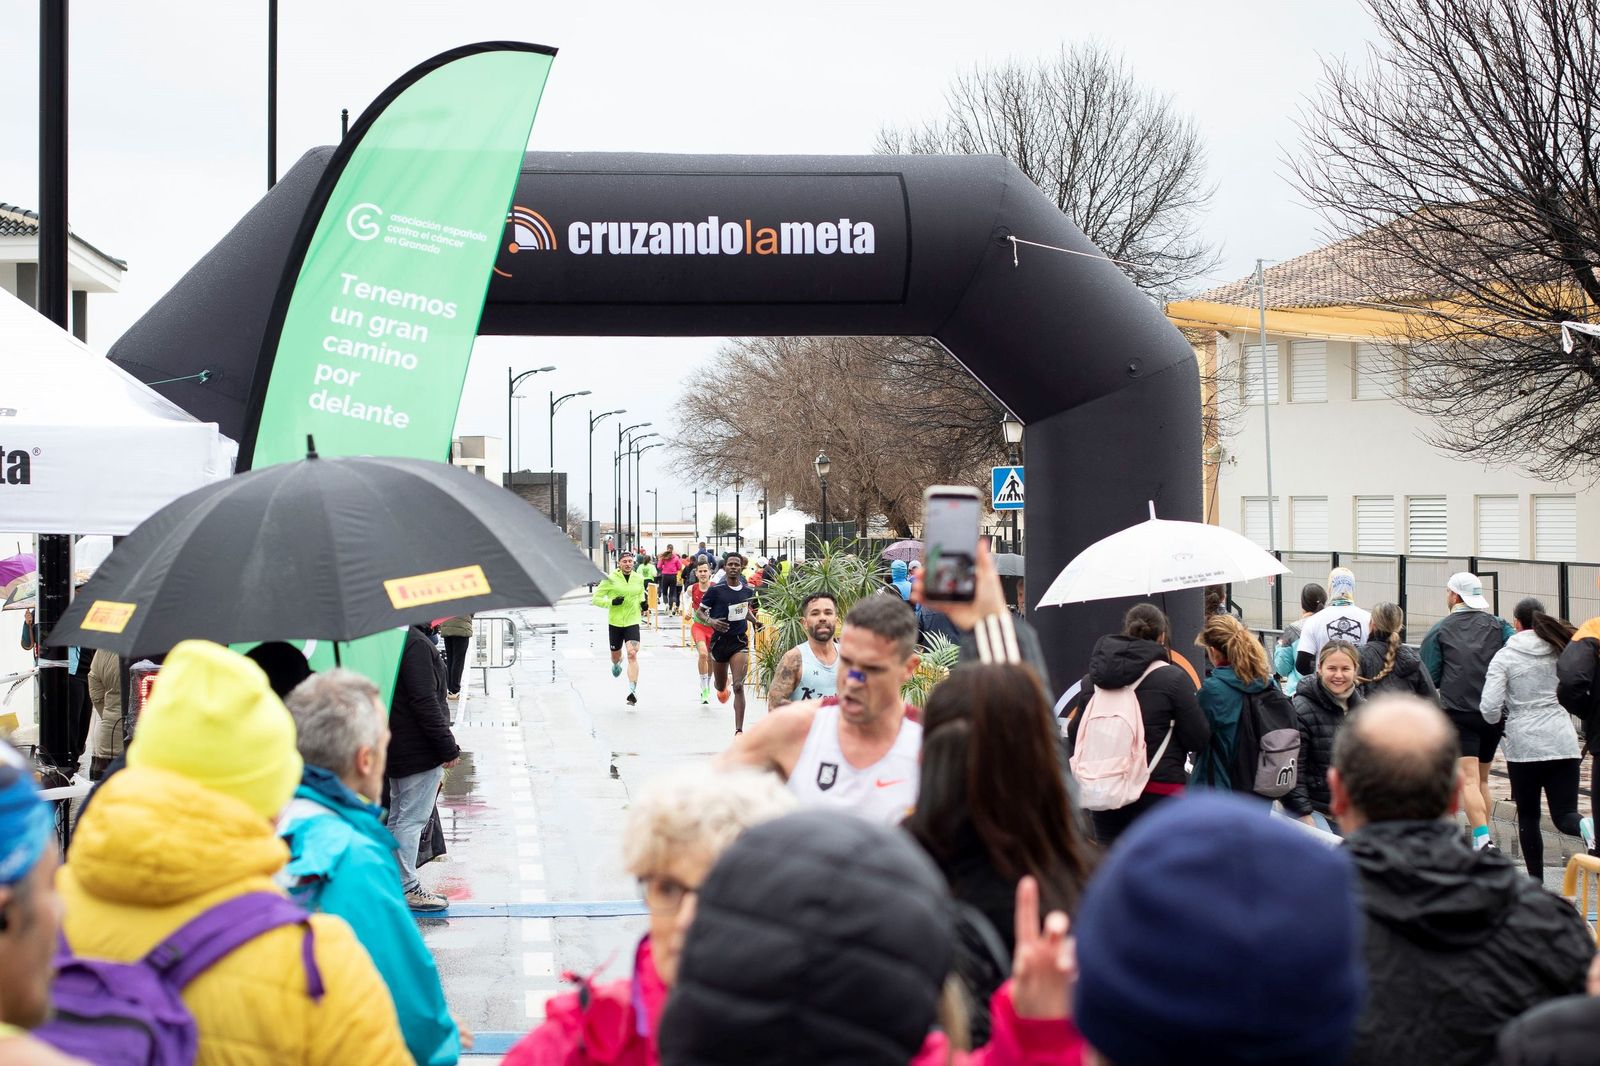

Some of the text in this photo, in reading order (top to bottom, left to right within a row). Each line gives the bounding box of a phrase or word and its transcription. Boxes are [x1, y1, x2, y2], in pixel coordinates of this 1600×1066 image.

[387, 224, 465, 248] contra el cáncer
[390, 214, 487, 242] asociación española
[383, 235, 440, 255] en Granada
[340, 272, 457, 320] Tenemos
[331, 305, 429, 343] un gran
[323, 335, 418, 371] camino
[313, 363, 361, 387] por
[308, 389, 410, 429] delante
